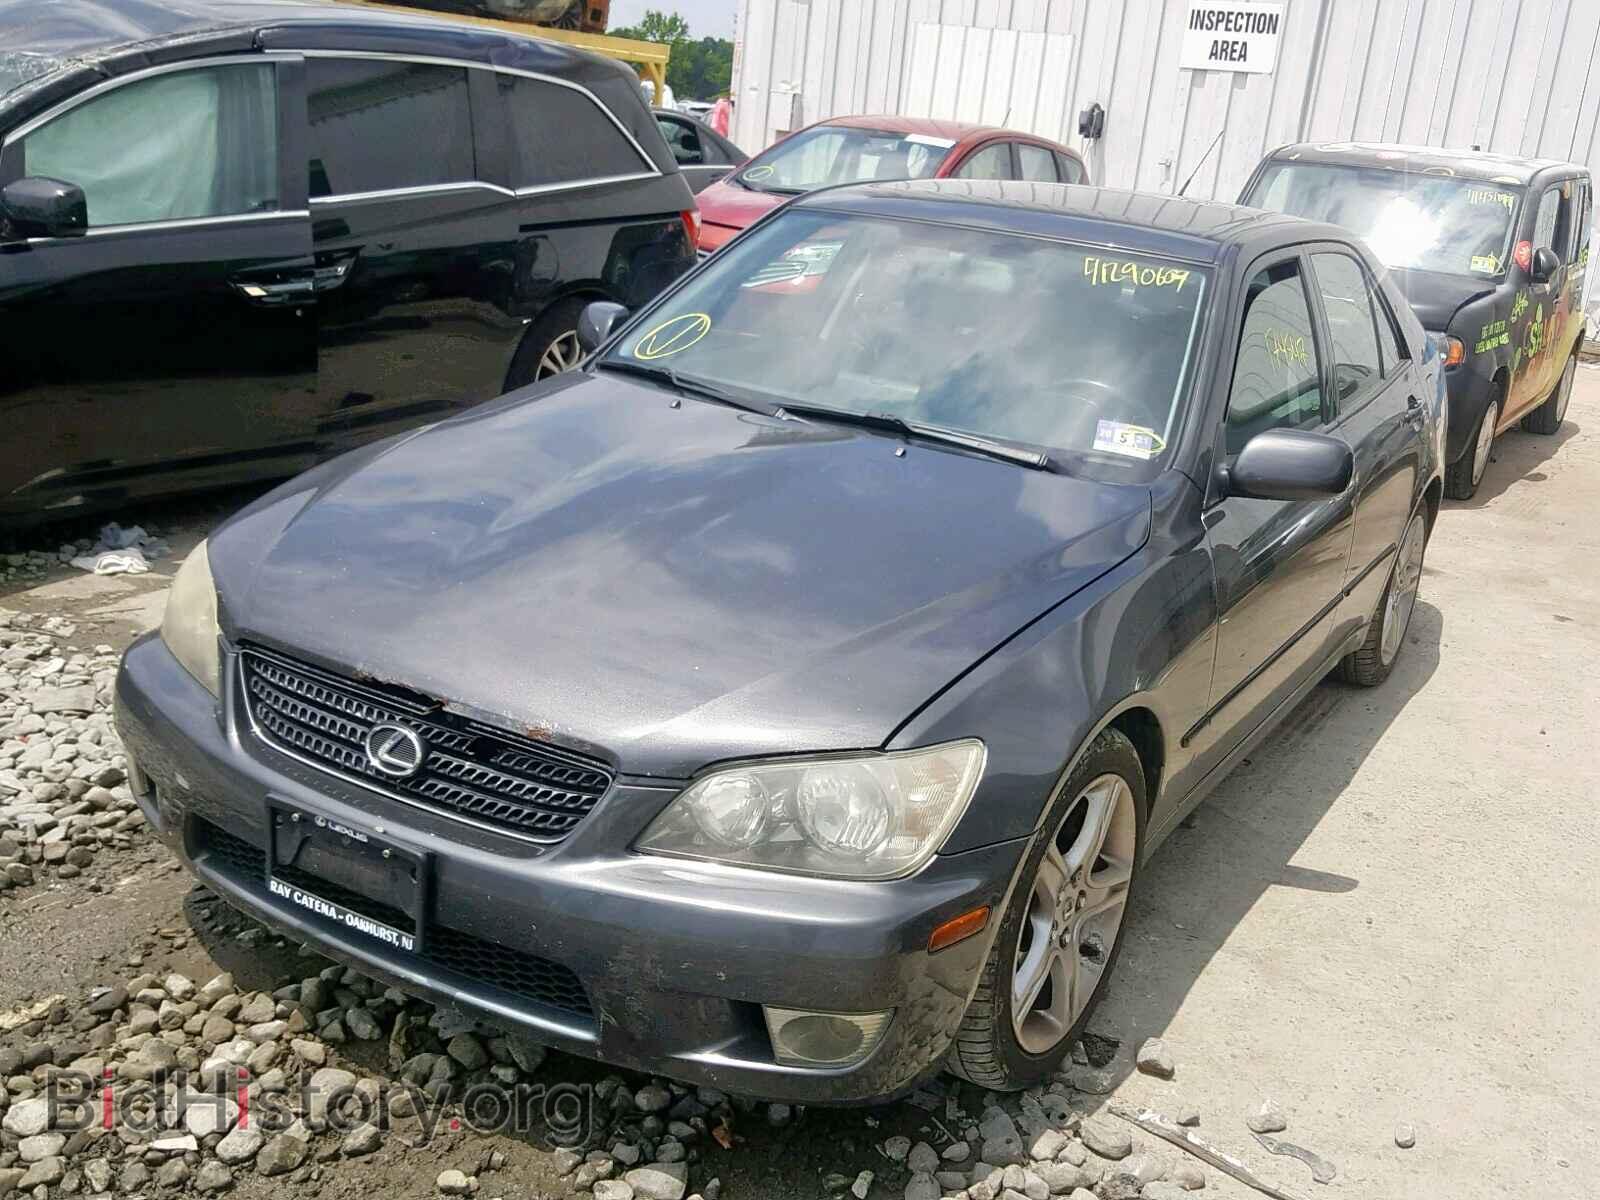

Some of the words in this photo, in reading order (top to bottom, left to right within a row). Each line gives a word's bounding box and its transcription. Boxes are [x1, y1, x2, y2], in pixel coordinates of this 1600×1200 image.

[1189, 9, 1279, 34] INSPECTION
[1208, 40, 1248, 62] AREA
[270, 880, 293, 899] RAY
[293, 891, 337, 920] CATENA
[401, 937, 414, 950] NJ
